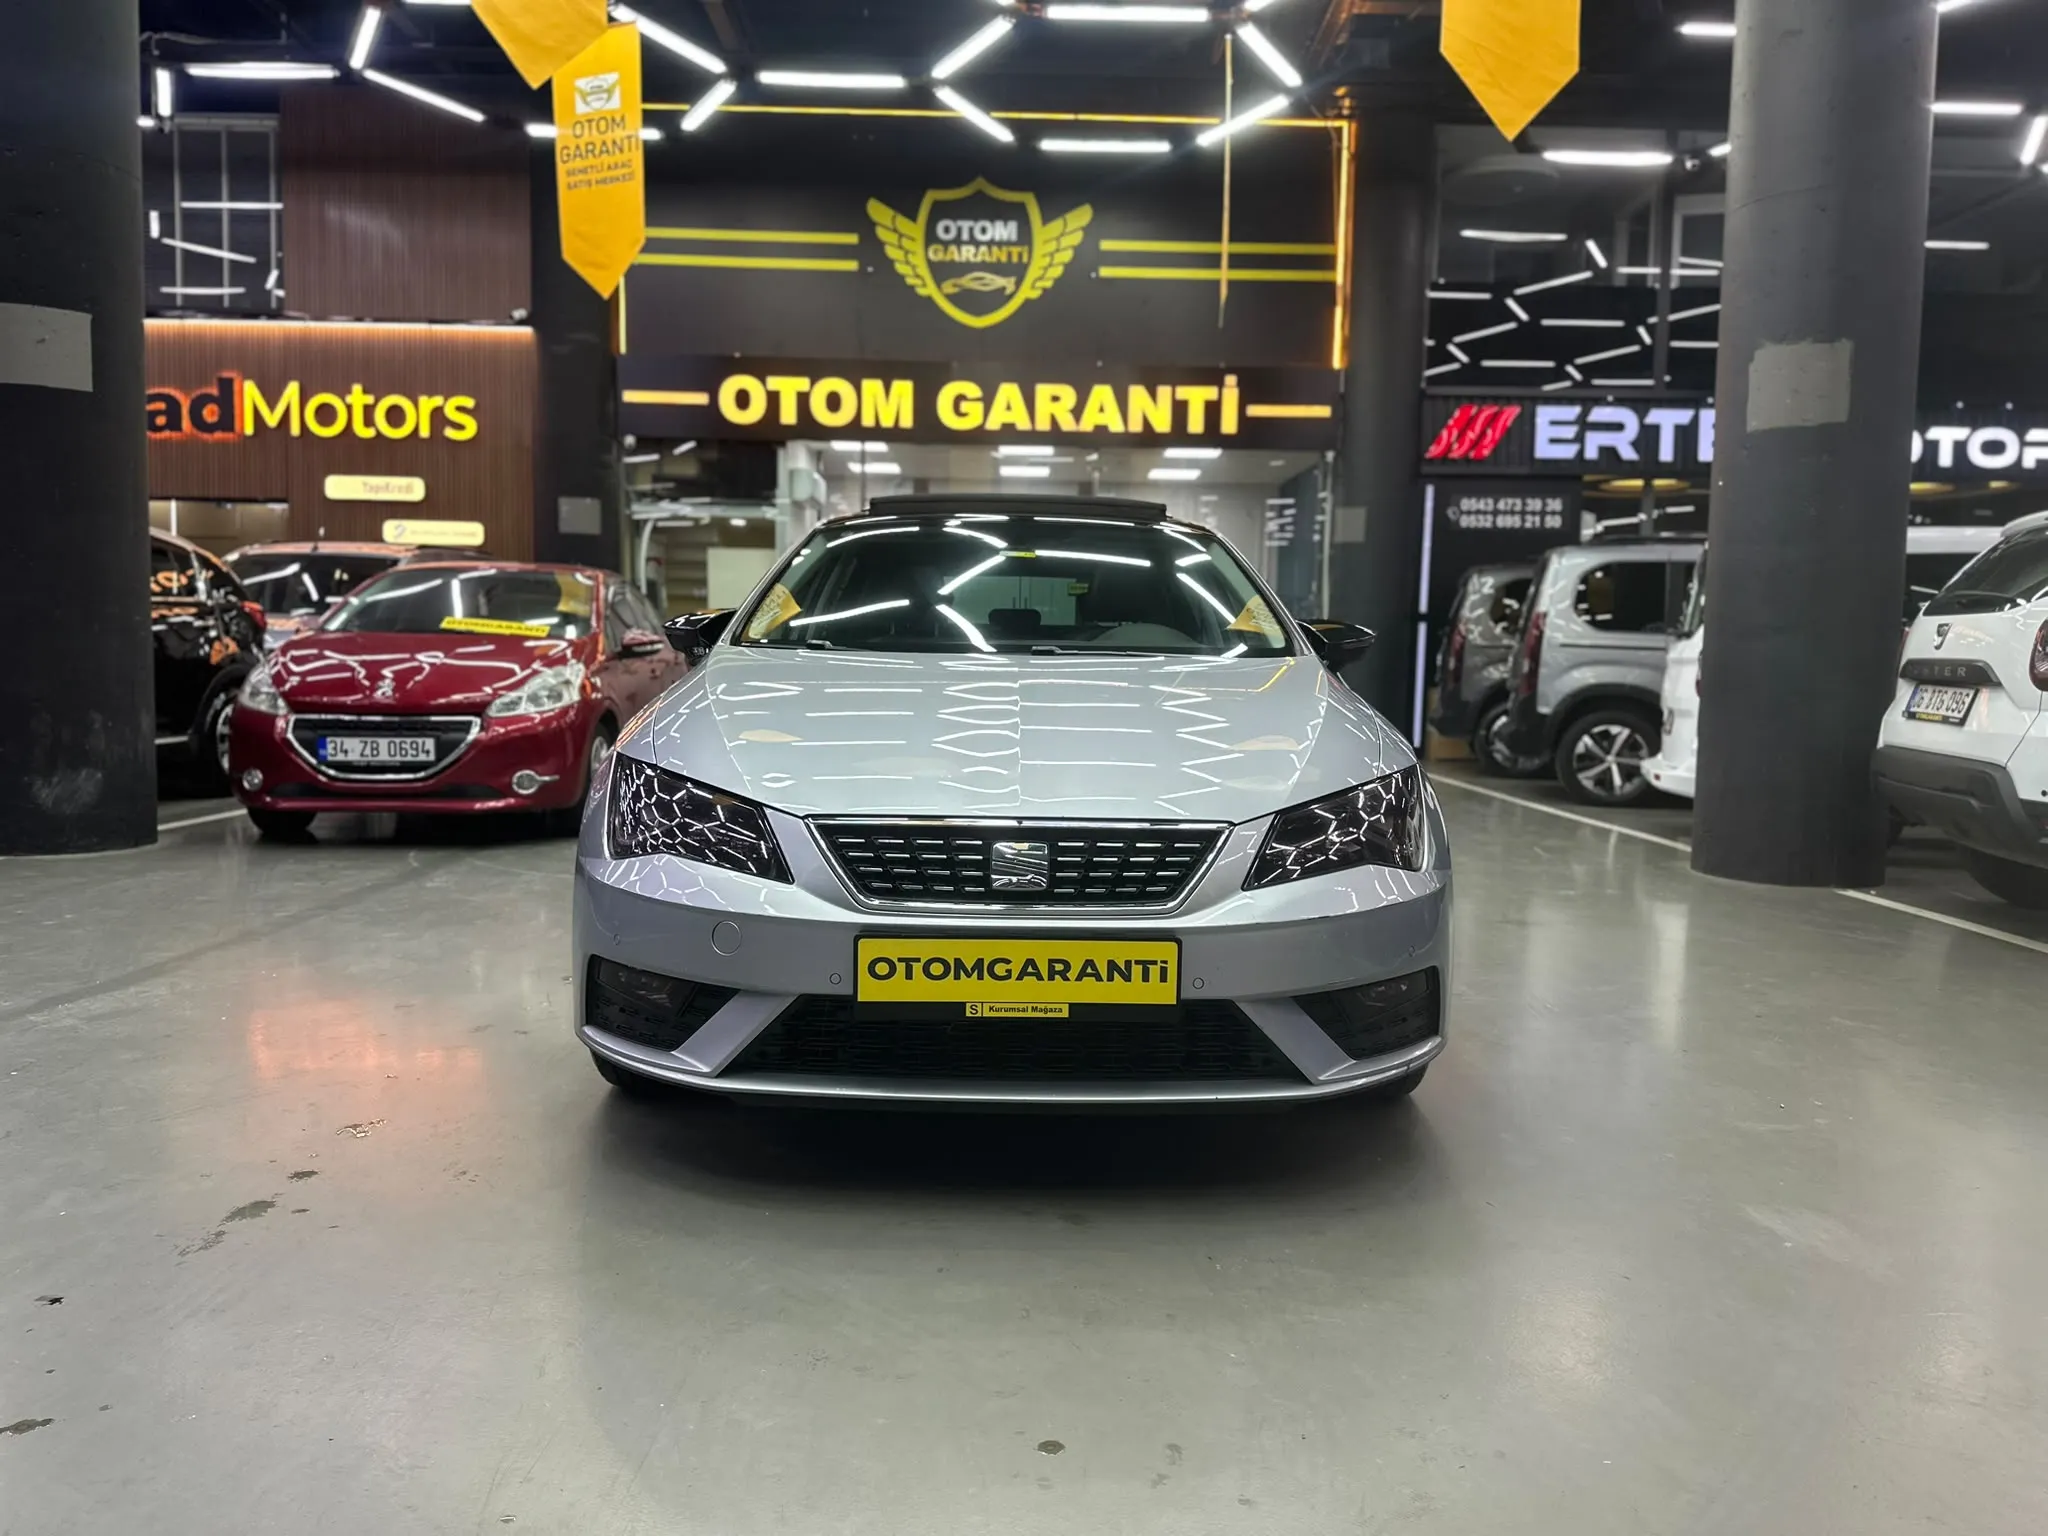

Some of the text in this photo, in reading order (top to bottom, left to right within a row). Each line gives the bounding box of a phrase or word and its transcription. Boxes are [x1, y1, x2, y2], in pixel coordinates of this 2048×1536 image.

[572, 114, 626, 139] OTOM
[935, 219, 1018, 241] OTOM
[717, 374, 914, 428] OTOM
[329, 740, 431, 758] 34 ZB 0694
[969, 1004, 1063, 1016] S Kurumsal Mağaza
